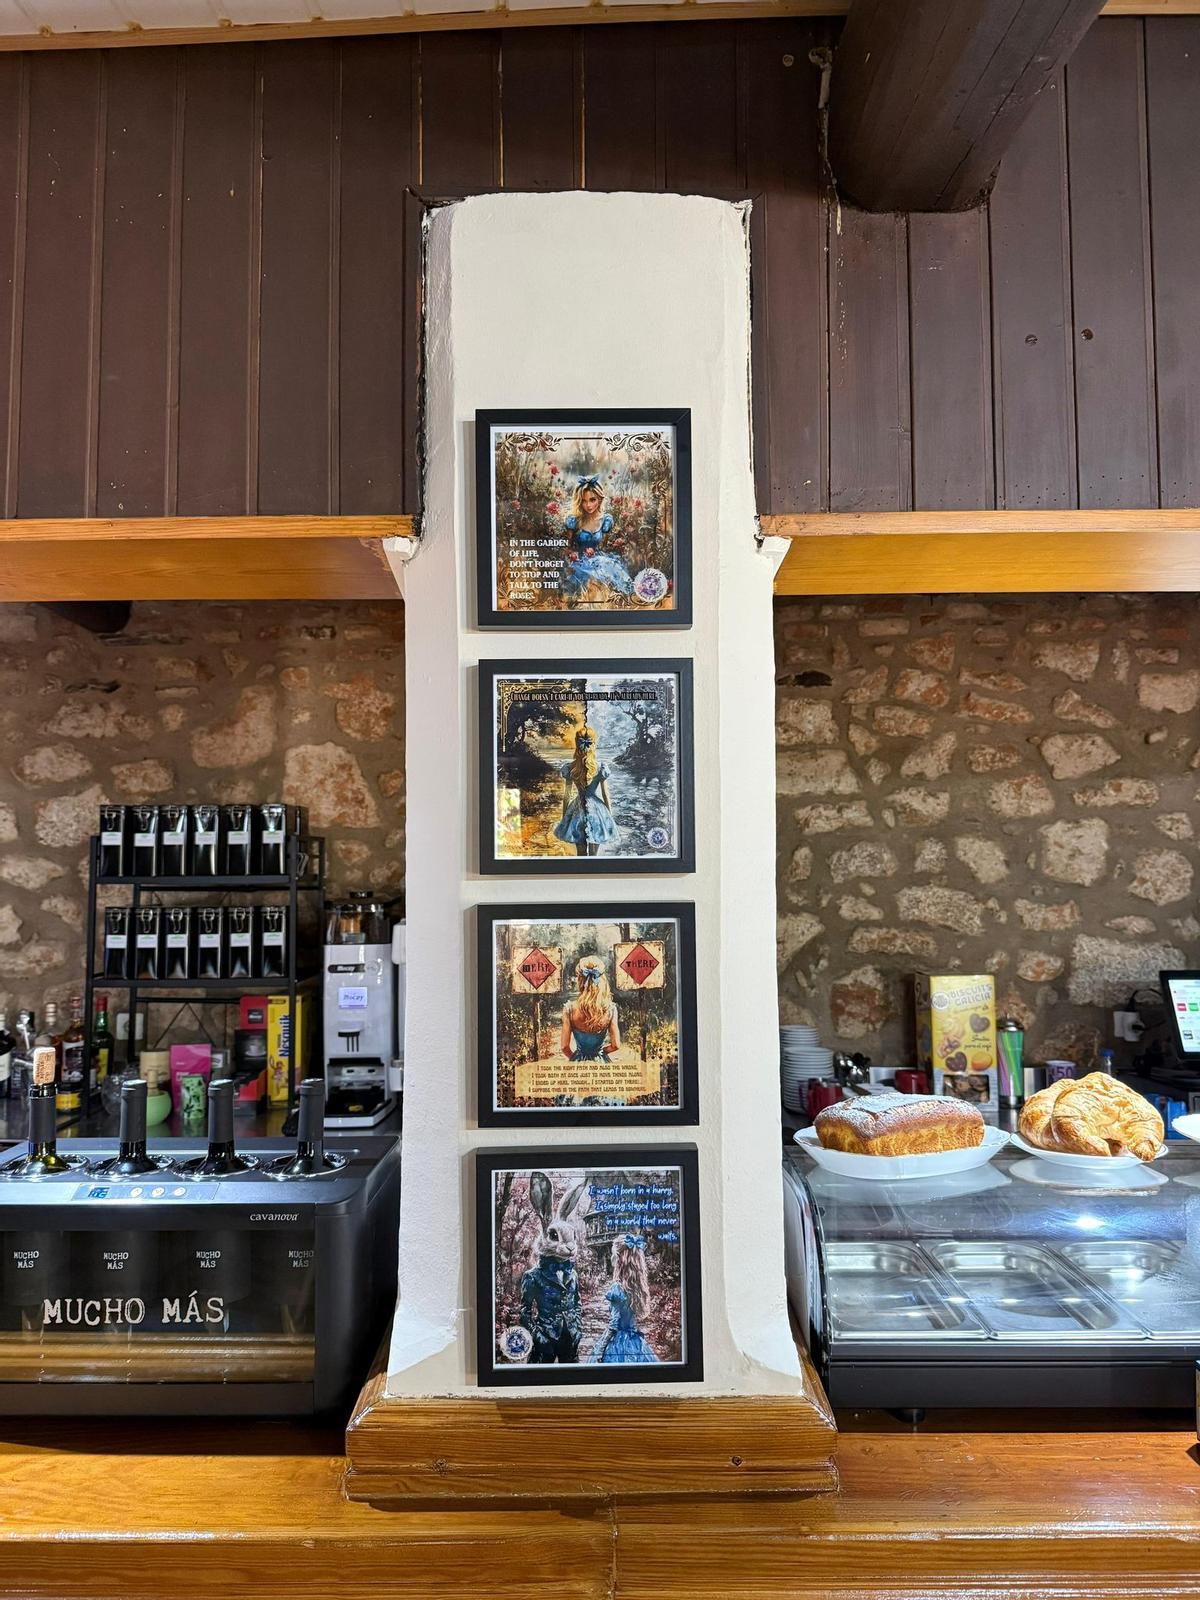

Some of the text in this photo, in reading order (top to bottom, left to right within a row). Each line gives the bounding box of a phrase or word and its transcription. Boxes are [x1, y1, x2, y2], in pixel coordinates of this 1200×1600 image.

[509, 539, 569, 547] IN THE GARDEN
[509, 550, 520, 558] OF
[509, 560, 565, 568] DON'T FORGET
[510, 581, 559, 589] TALK TO THE
[589, 1186, 595, 1194] I
[597, 1185, 618, 1194] wasn't
[620, 1184, 636, 1195] born
[638, 1186, 645, 1194] in
[627, 1201, 648, 1212] stayed
[650, 1201, 660, 1209] too
[662, 1200, 677, 1212] long
[250, 1212, 298, 1222] cavanova
[606, 1217, 612, 1225] in
[621, 1216, 640, 1225] world
[643, 1216, 656, 1225] that
[13, 1251, 40, 1260] MUCHO
[103, 1252, 129, 1260] MUCHO
[196, 1250, 221, 1259] MUCHO
[288, 1249, 314, 1259] MUCHO
[17, 1260, 34, 1269] MÁS
[107, 1261, 123, 1270] MÁS
[200, 1259, 216, 1268] MÁS
[292, 1259, 309, 1267] MÁS
[43, 1290, 225, 1326] MUCHO MÁS
